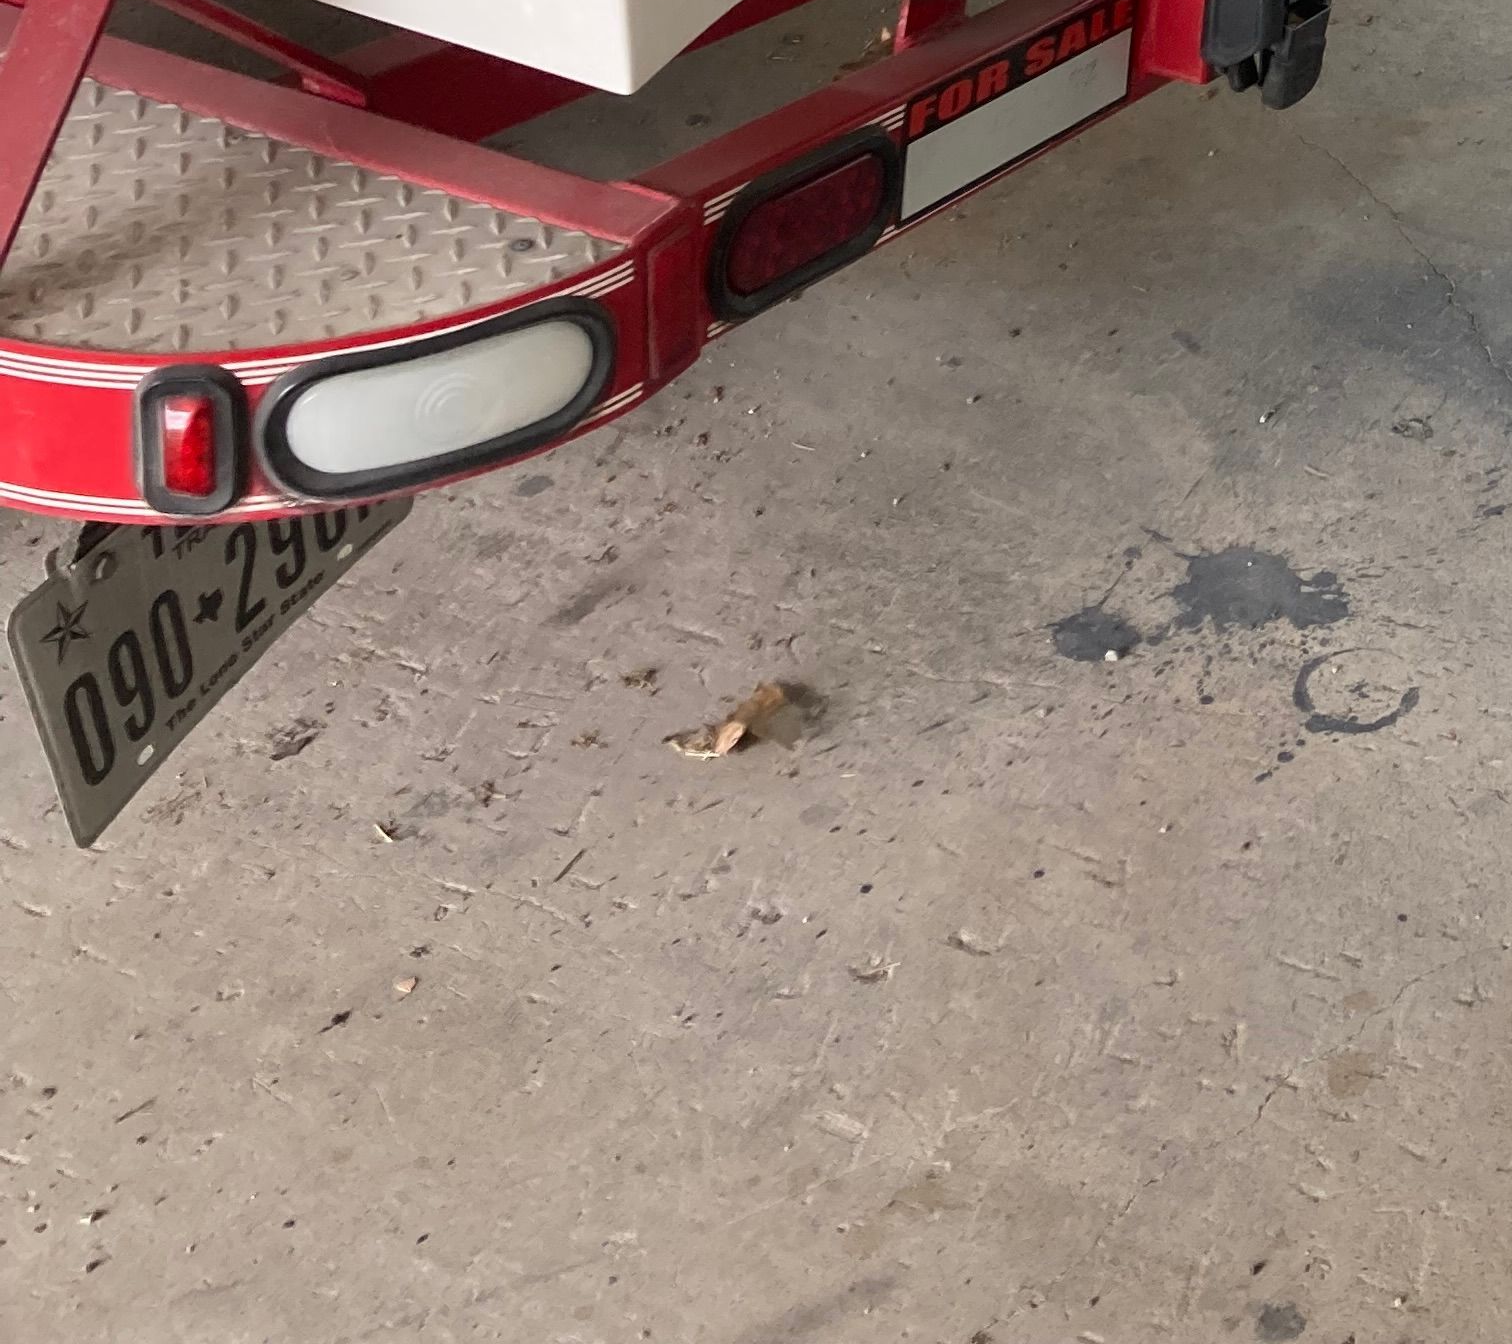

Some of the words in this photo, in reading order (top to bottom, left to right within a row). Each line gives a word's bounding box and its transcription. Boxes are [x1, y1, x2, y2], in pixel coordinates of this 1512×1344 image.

[909, 59, 1010, 138] FOR
[63, 589, 194, 786] 090
[225, 499, 386, 634] 29
[165, 697, 197, 731] The
[201, 653, 238, 696] Lone
[241, 613, 275, 652] Star
